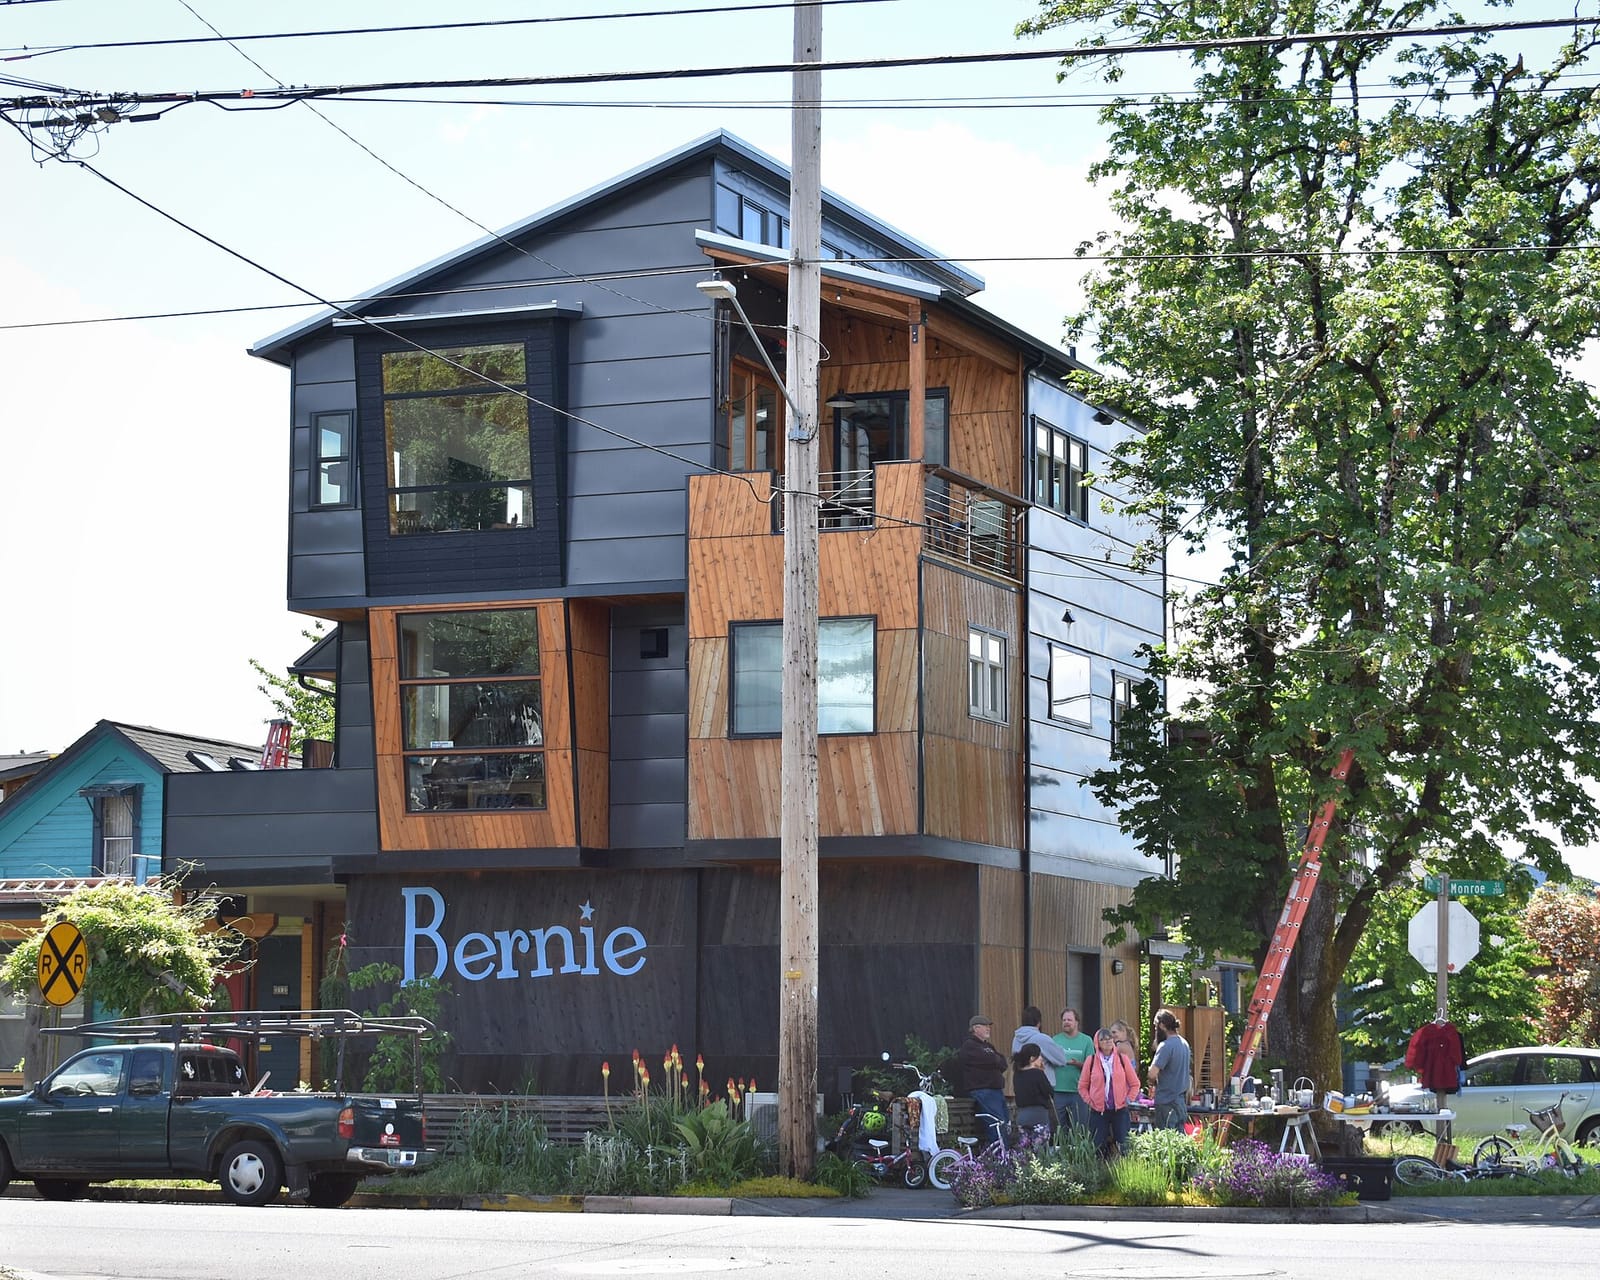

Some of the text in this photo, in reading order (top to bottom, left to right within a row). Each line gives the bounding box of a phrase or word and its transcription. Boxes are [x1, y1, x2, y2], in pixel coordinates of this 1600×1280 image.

[1450, 883, 1485, 894] Monroe
[401, 886, 648, 988] Bernie
[42, 955, 52, 975] R
[73, 955, 83, 974] R
